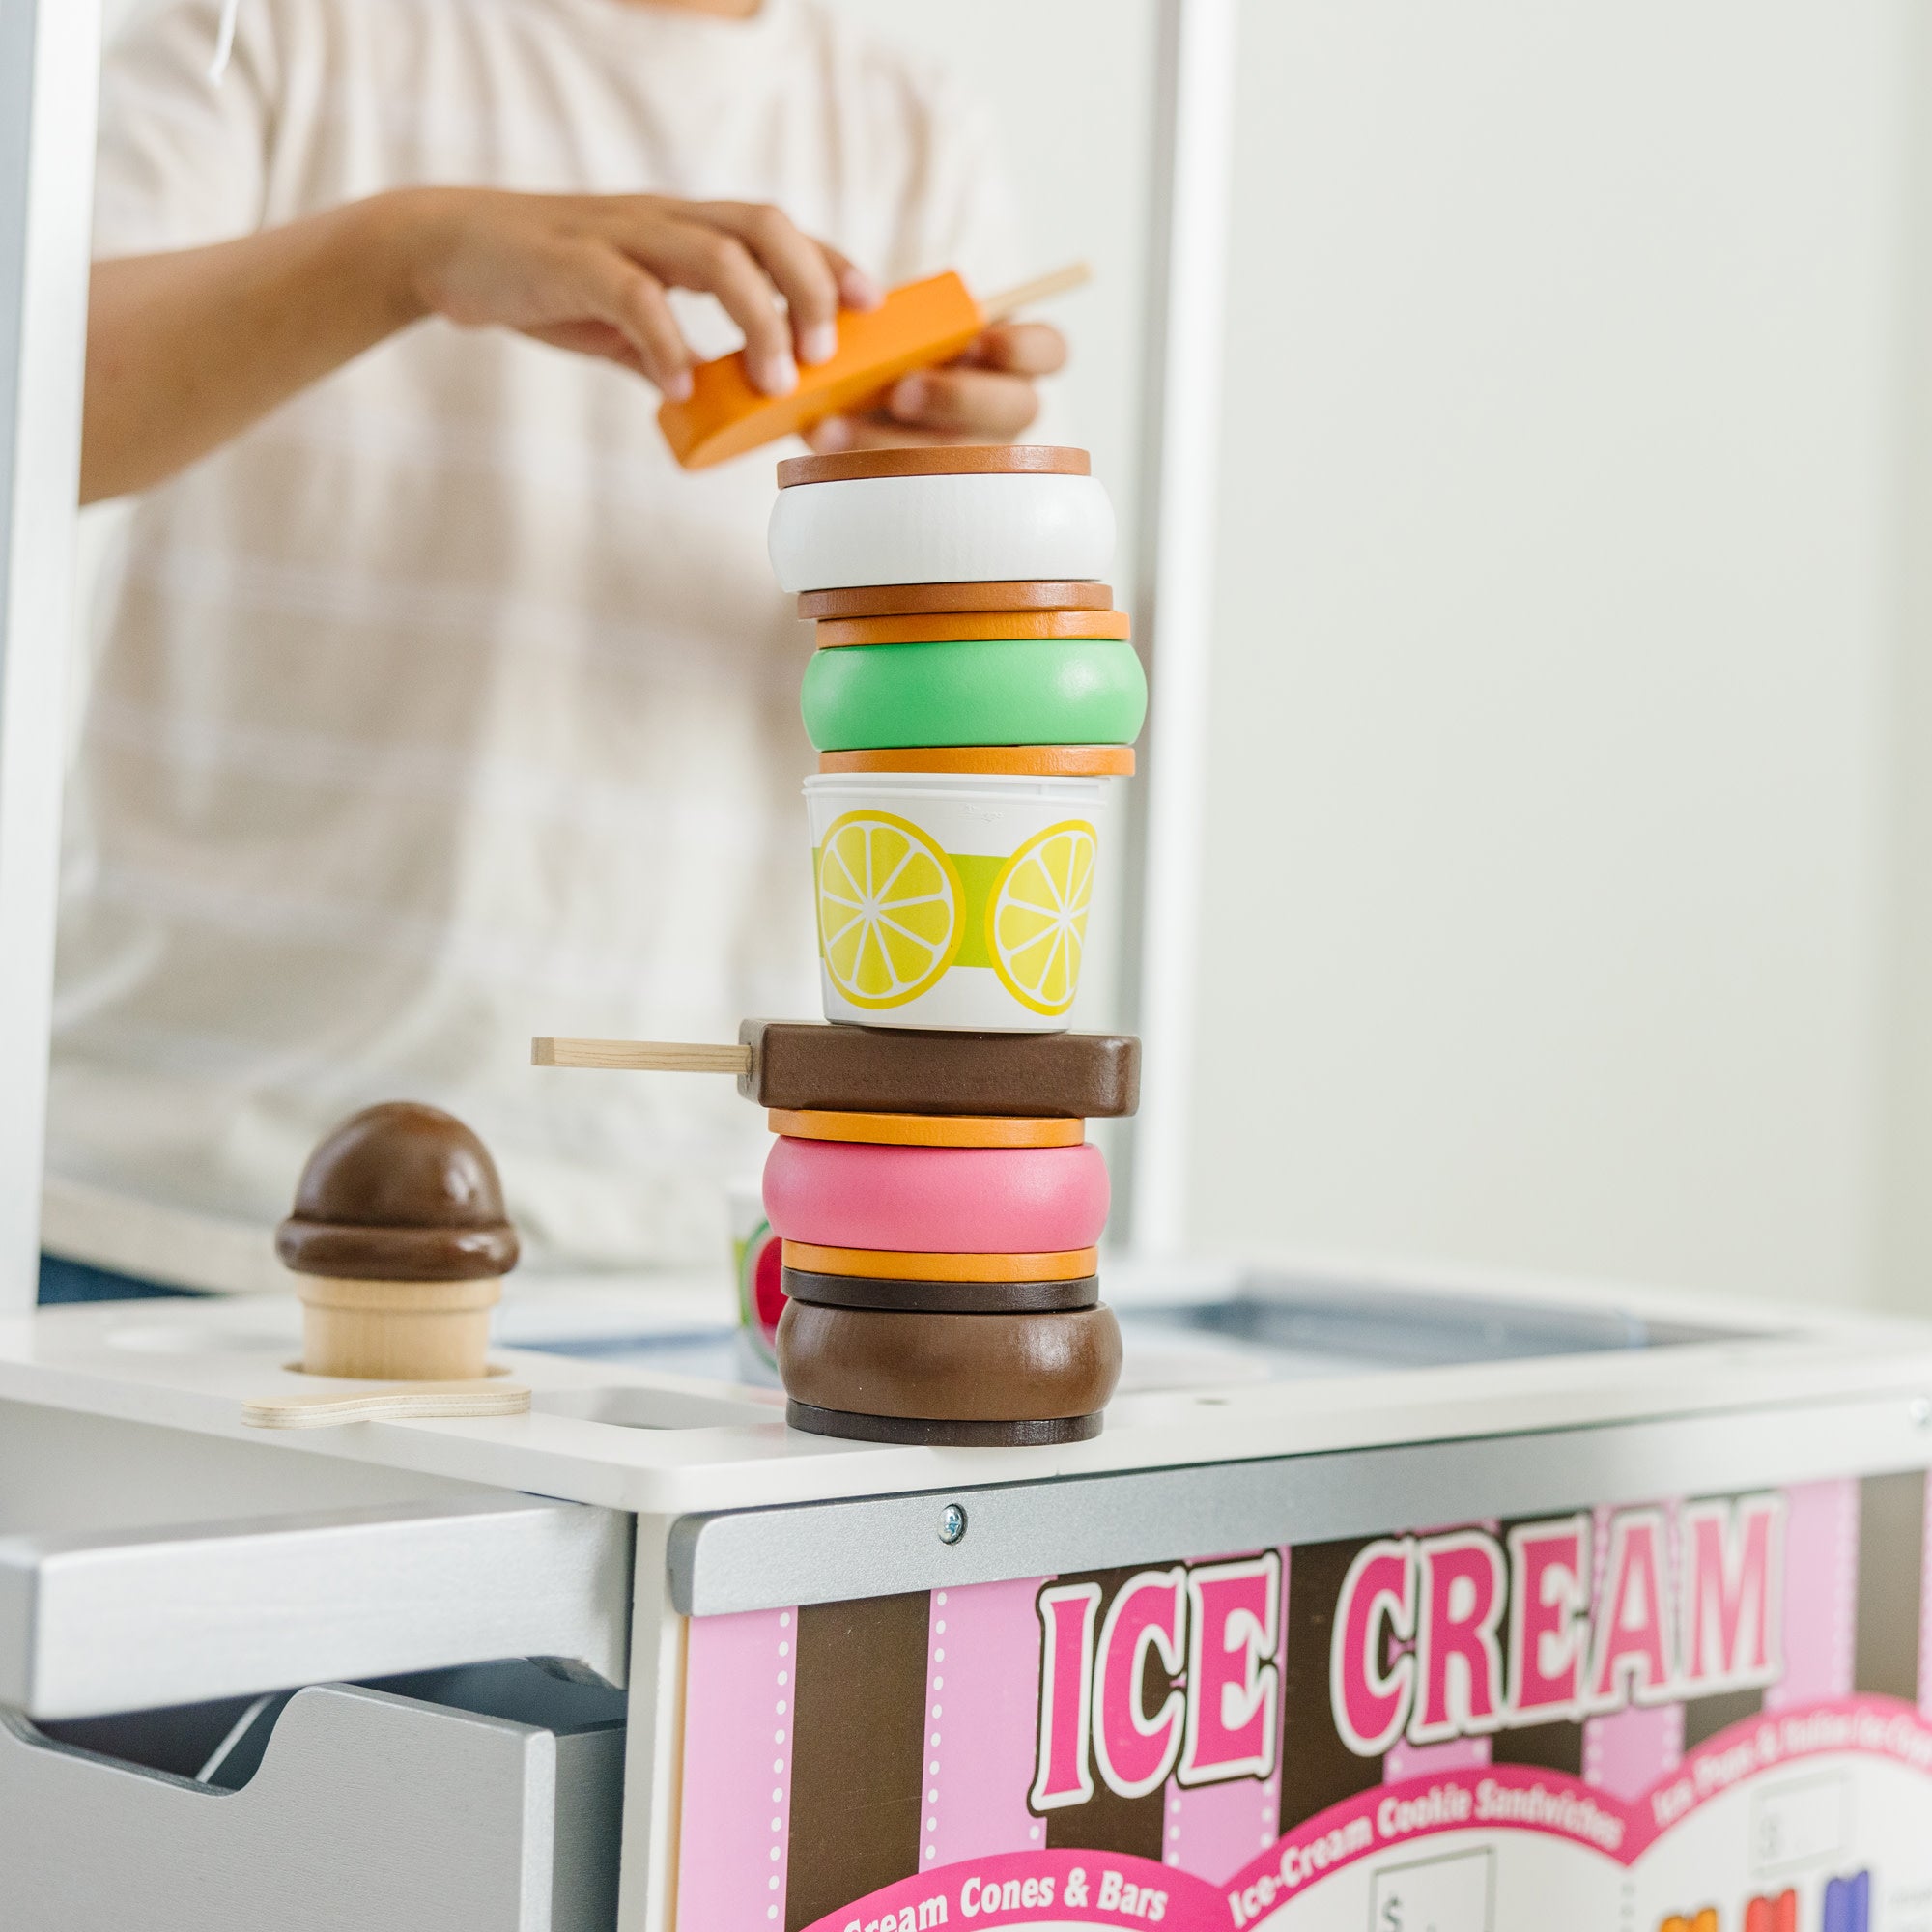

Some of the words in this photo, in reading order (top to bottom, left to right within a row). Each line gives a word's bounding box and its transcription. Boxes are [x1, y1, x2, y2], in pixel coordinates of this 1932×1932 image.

[1031, 1551, 1279, 1811] ICE
[1330, 1492, 1785, 1757] CREAM
[960, 1876, 1056, 1918] Cones
[1064, 1867, 1090, 1908] &
[1096, 1870, 1168, 1922] Bars
[1228, 1816, 1374, 1929] Ice-Cream
[1377, 1780, 1473, 1837] Cookie
[1475, 1777, 1626, 1852] Sandwiches
